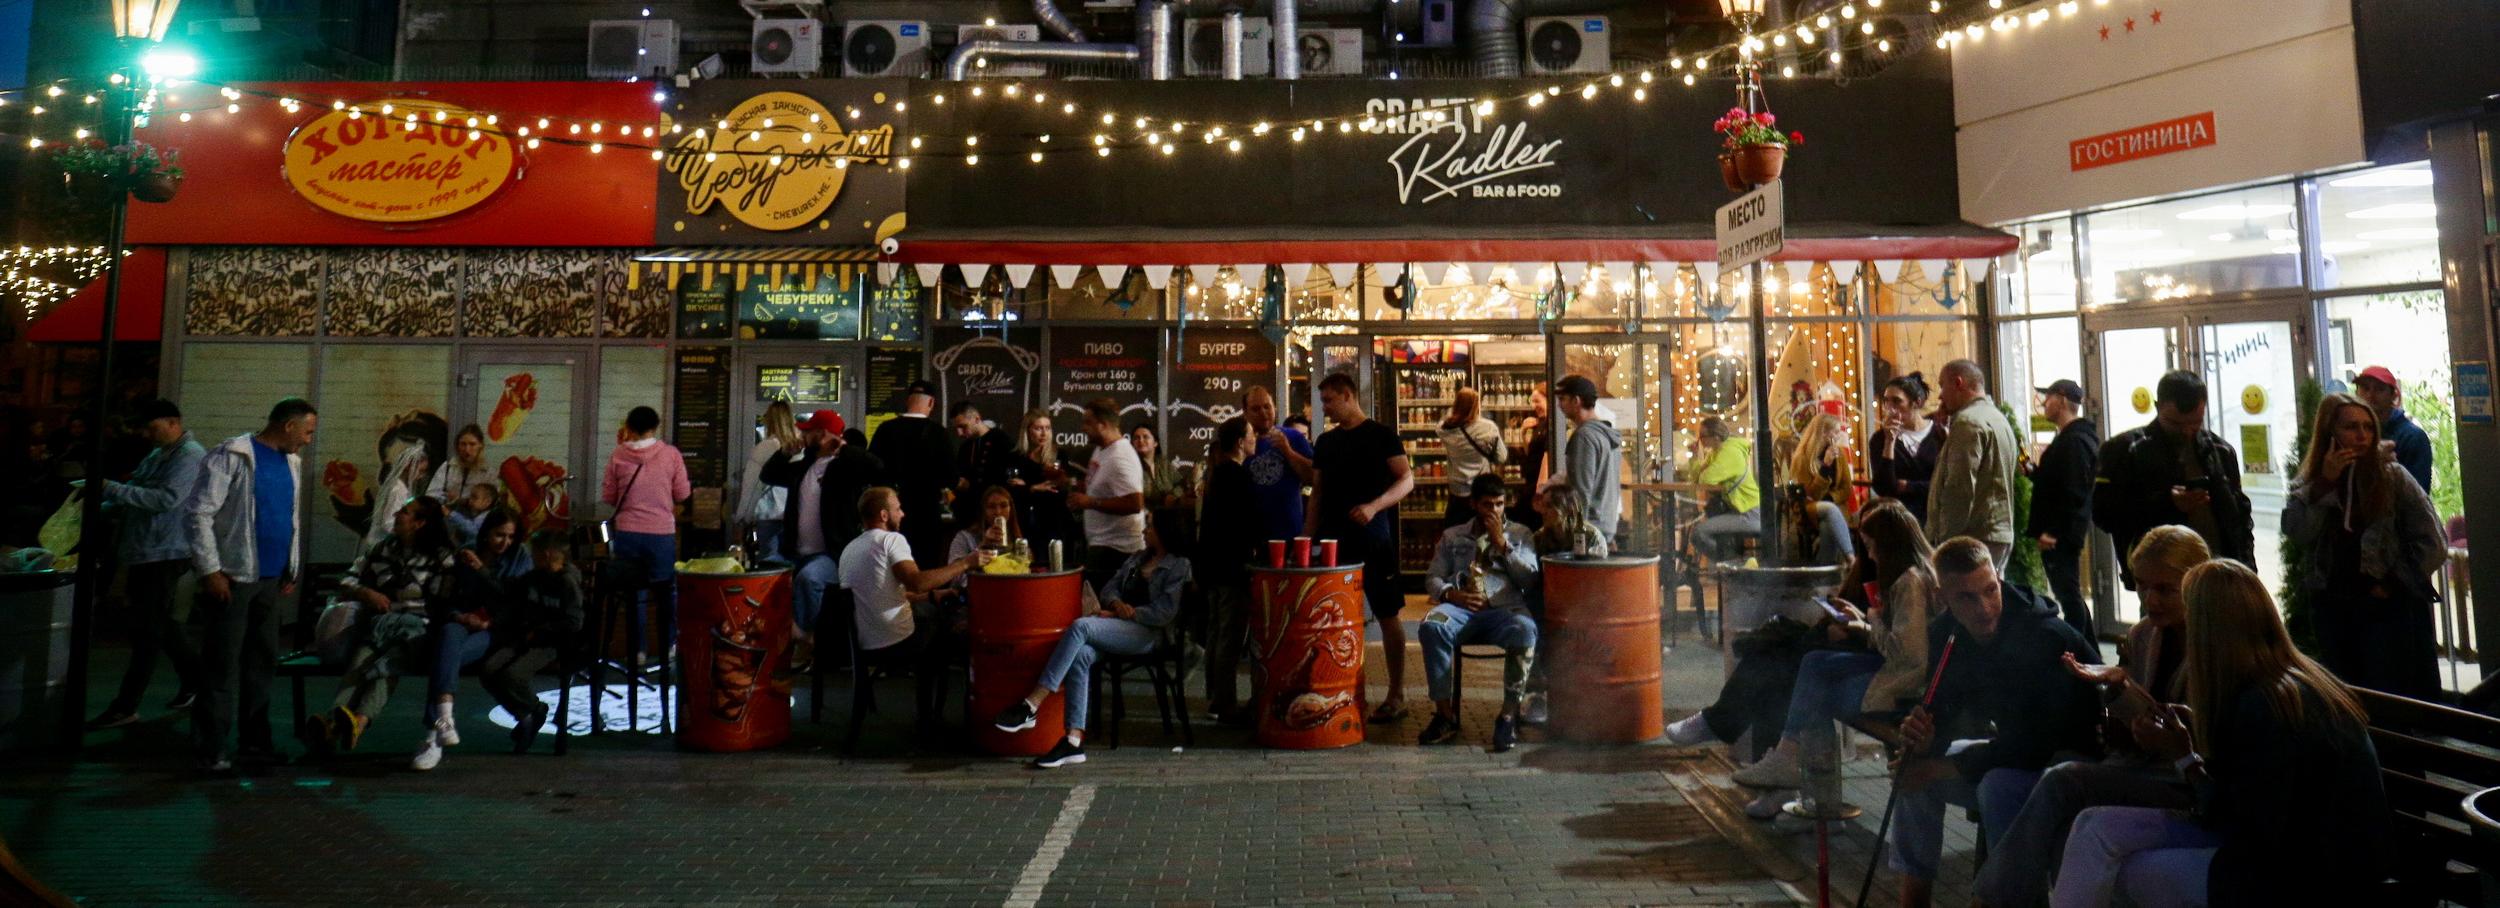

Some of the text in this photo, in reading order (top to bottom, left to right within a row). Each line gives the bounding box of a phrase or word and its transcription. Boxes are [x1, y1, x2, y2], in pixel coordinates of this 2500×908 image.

[1365, 98, 1485, 135] CRAFTY
[2074, 119, 2208, 165] ГОСТИНИЦА
[329, 152, 463, 190] мастер
[1387, 121, 1563, 204] Radler
[428, 190, 458, 208] 1999
[1727, 193, 1766, 231] МЕСТО
[1734, 225, 1783, 262] РАЗГРУЗКИ
[766, 293, 835, 305] ЧЕБУРЕКИ
[1084, 343, 1124, 355] ПИВО
[1199, 343, 1246, 356] БУРГЕР
[957, 363, 993, 376] CRAFTY
[1071, 370, 1095, 380] Кран
[1110, 370, 1127, 379] 160
[1063, 381, 1102, 392] Бутылка
[1116, 382, 1134, 391] 200
[1203, 377, 1242, 393] 290 р
